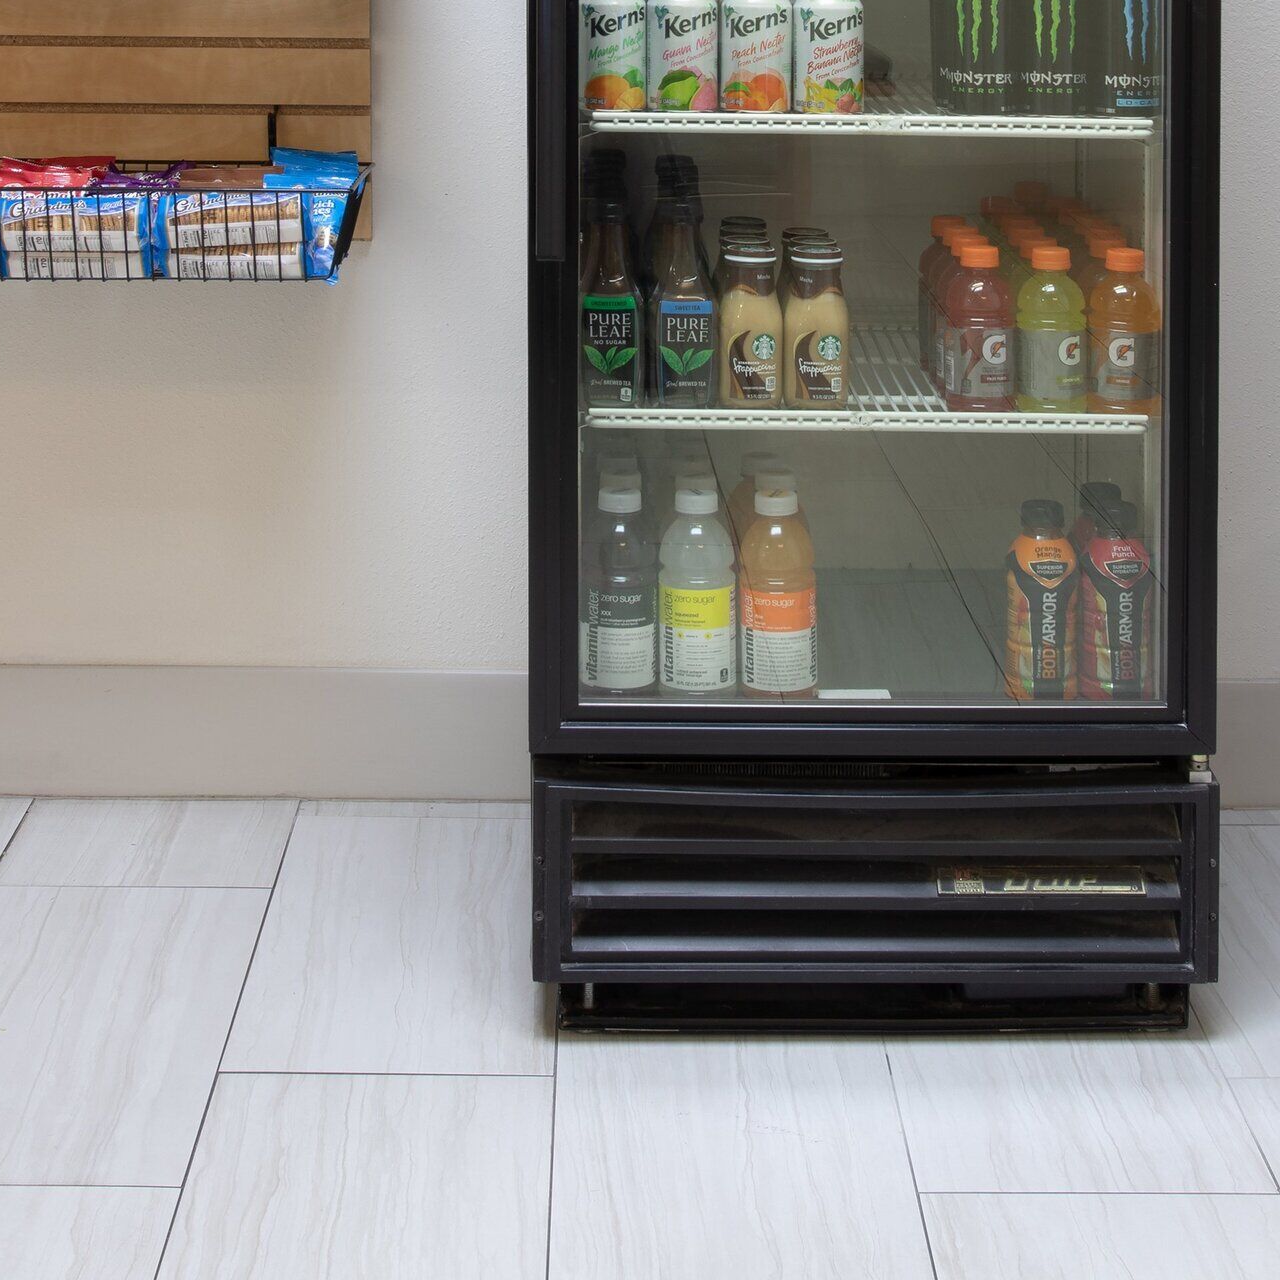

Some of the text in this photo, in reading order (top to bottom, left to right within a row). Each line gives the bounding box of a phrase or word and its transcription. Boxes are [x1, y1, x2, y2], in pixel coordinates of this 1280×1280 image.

[589, 312, 632, 325] PURE
[667, 317, 709, 330] PURE
[589, 325, 631, 338] LEAF
[667, 330, 709, 342] LEAF
[1035, 546, 1062, 554] Orange
[1111, 551, 1136, 559] Punch
[600, 593, 642, 604] zero sugar
[674, 594, 716, 606] zero sugar
[754, 597, 795, 608] zero sugar
